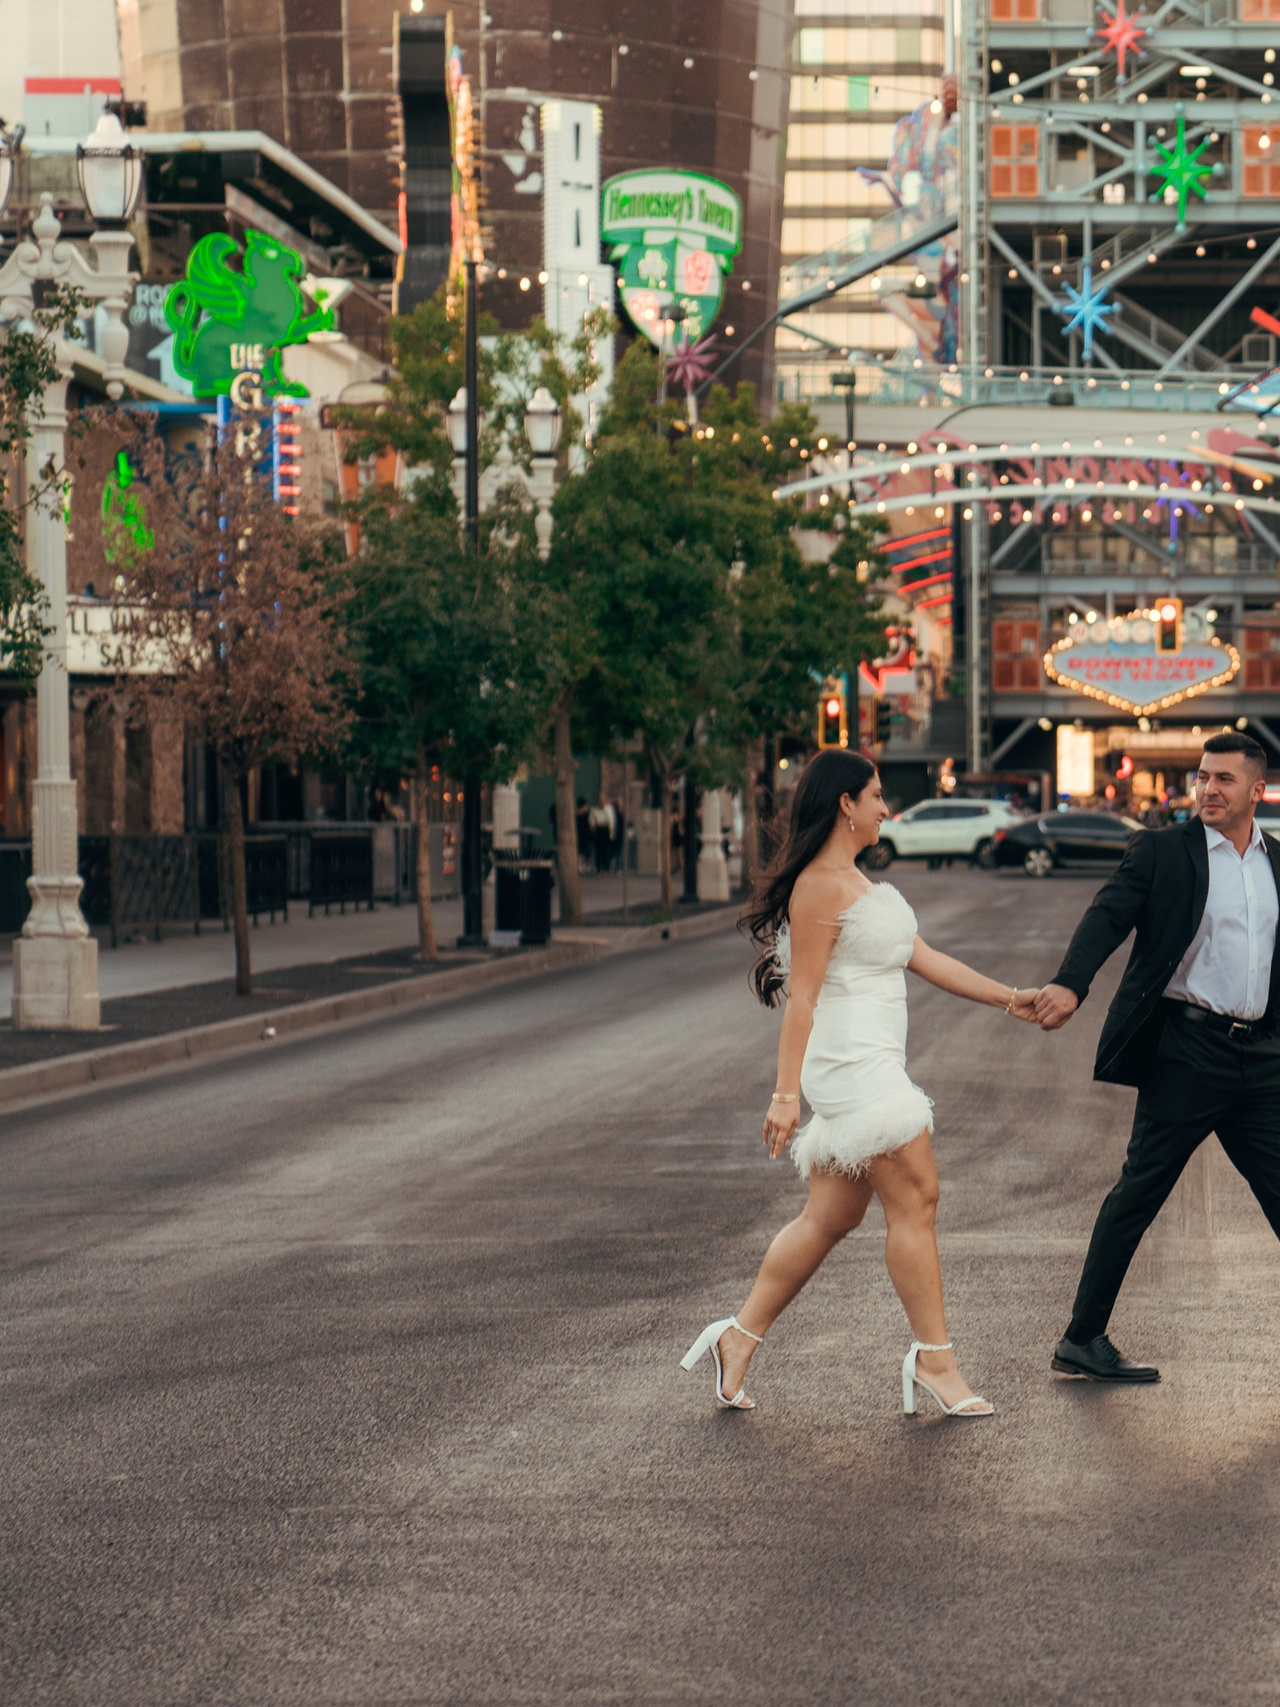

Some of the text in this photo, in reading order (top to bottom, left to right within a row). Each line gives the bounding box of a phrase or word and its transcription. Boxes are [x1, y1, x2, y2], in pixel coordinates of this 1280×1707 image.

[698, 188, 734, 235] Tavern
[1067, 657, 1215, 669] DOWNTOWN
[1085, 668, 1198, 681] LAS VEGAS
